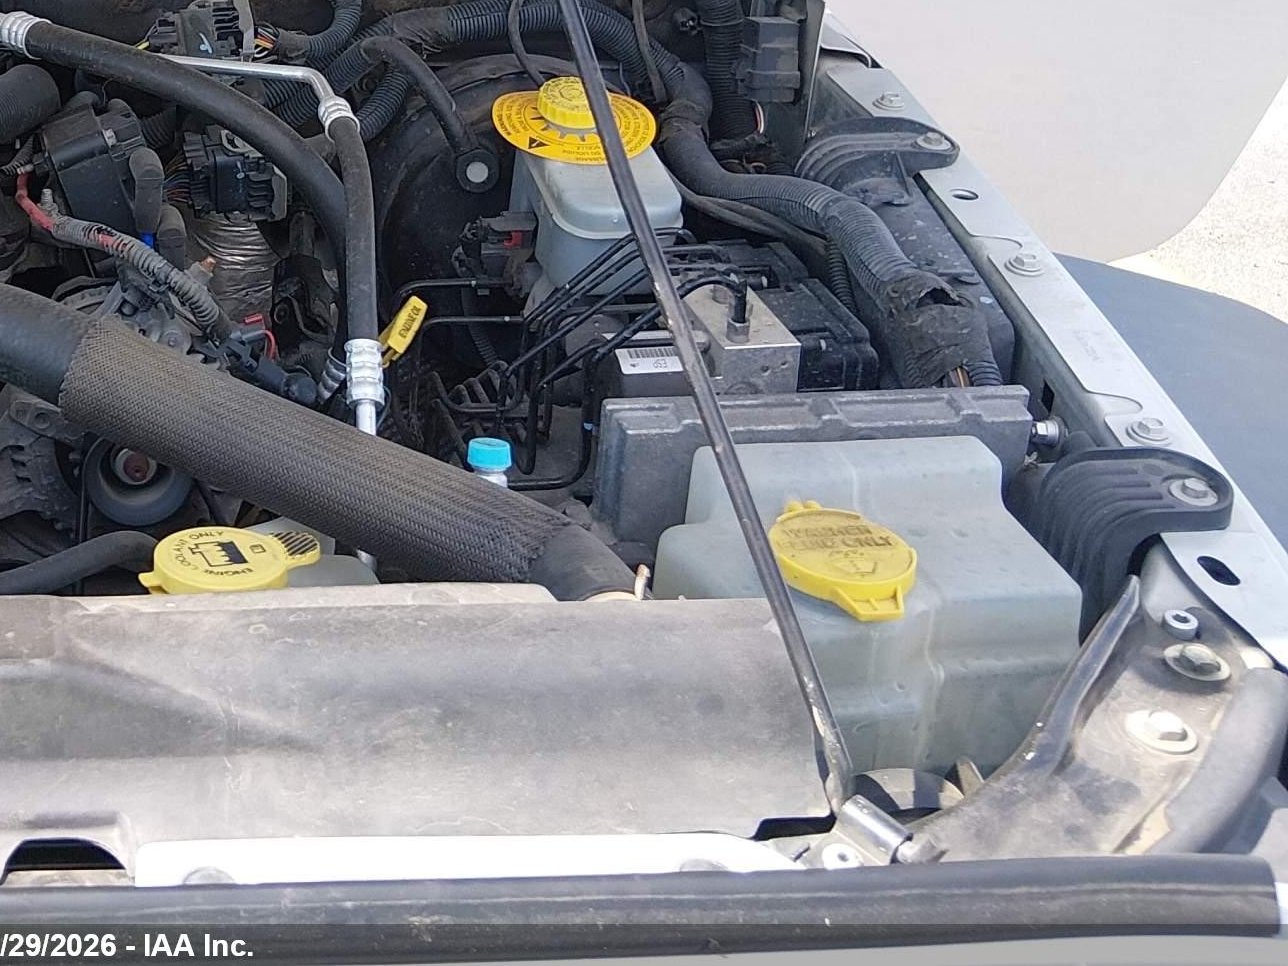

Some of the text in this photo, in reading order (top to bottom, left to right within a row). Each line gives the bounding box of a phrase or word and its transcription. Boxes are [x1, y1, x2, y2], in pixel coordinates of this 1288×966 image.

[173, 530, 254, 577] ENGINE COOLANT ONLY
[841, 536, 894, 548] ONLY
